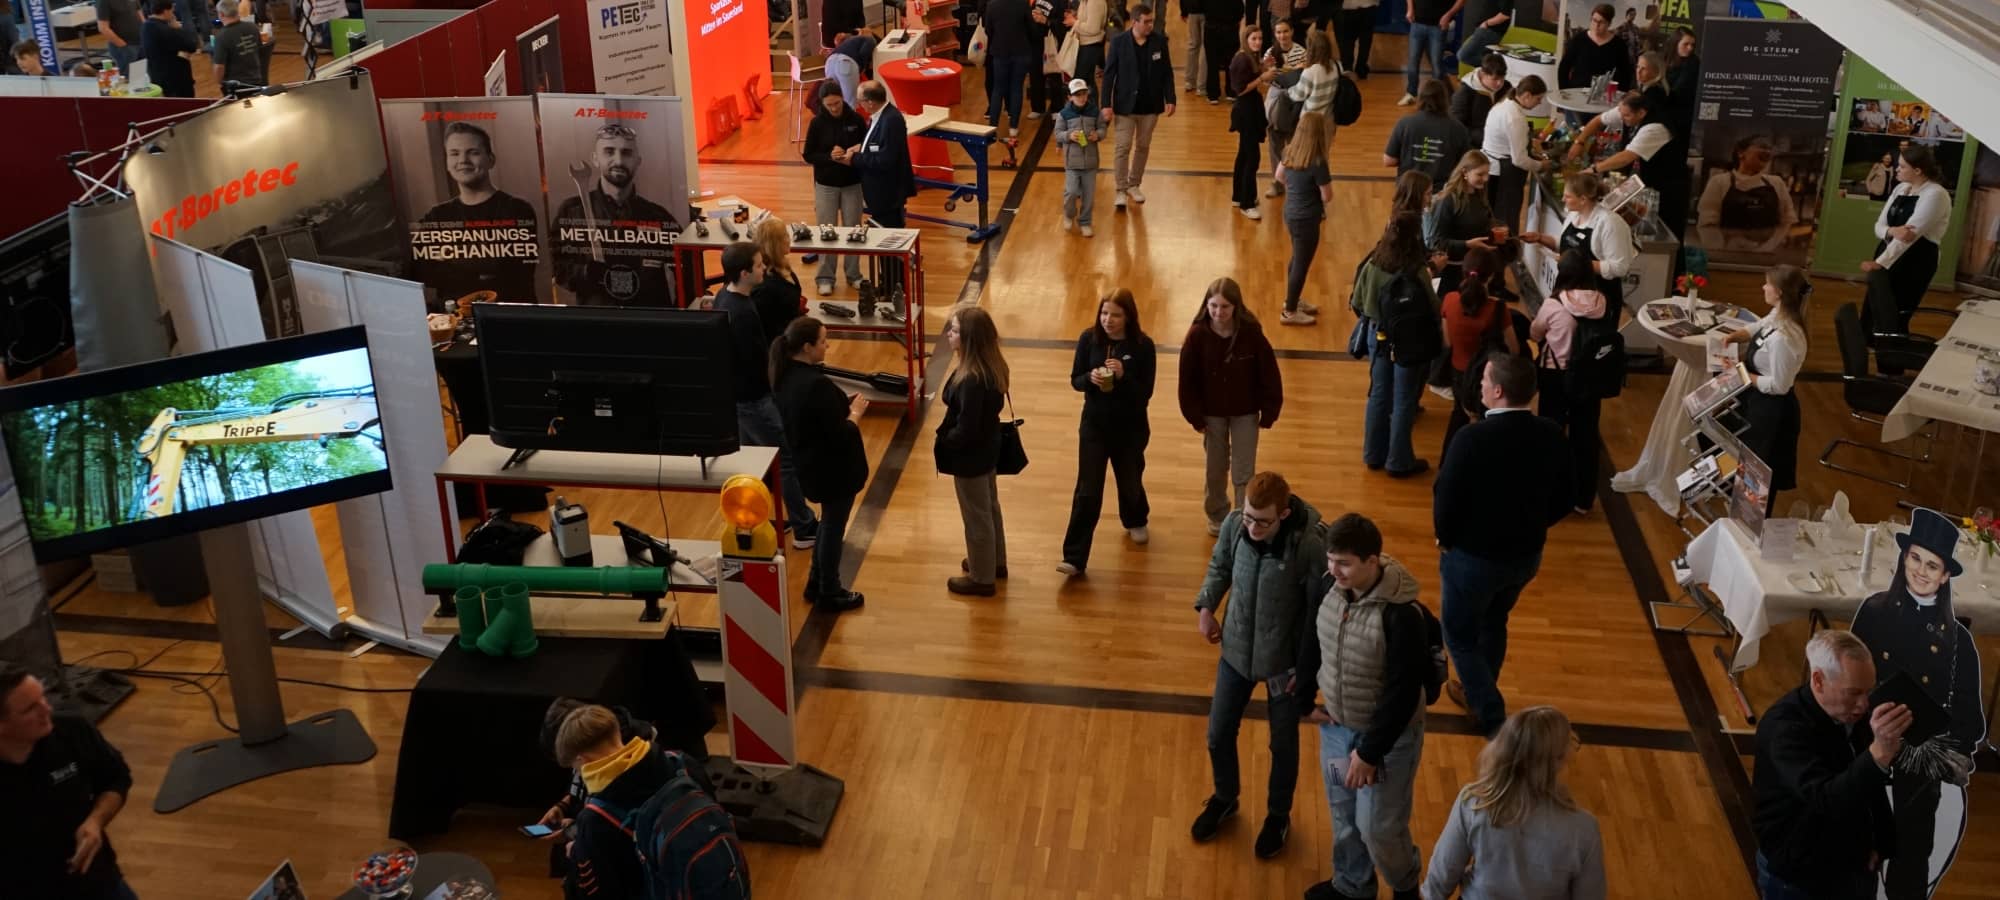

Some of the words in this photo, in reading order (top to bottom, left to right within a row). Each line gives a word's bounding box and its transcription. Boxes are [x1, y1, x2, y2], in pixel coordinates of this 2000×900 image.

[601, 2, 641, 29] PETEC
[34, 22, 55, 67] KOMM
[1743, 45, 1759, 53] DIE
[1764, 46, 1800, 54] STERNE
[1704, 71, 1732, 81] DEINE
[1733, 73, 1788, 82] AUSBILDUNG
[1801, 76, 1831, 84] HOTEL
[410, 228, 537, 244] ZERSPANUNGS-
[412, 243, 539, 260] MECHANIKER
[223, 421, 276, 438] TRIPPE
